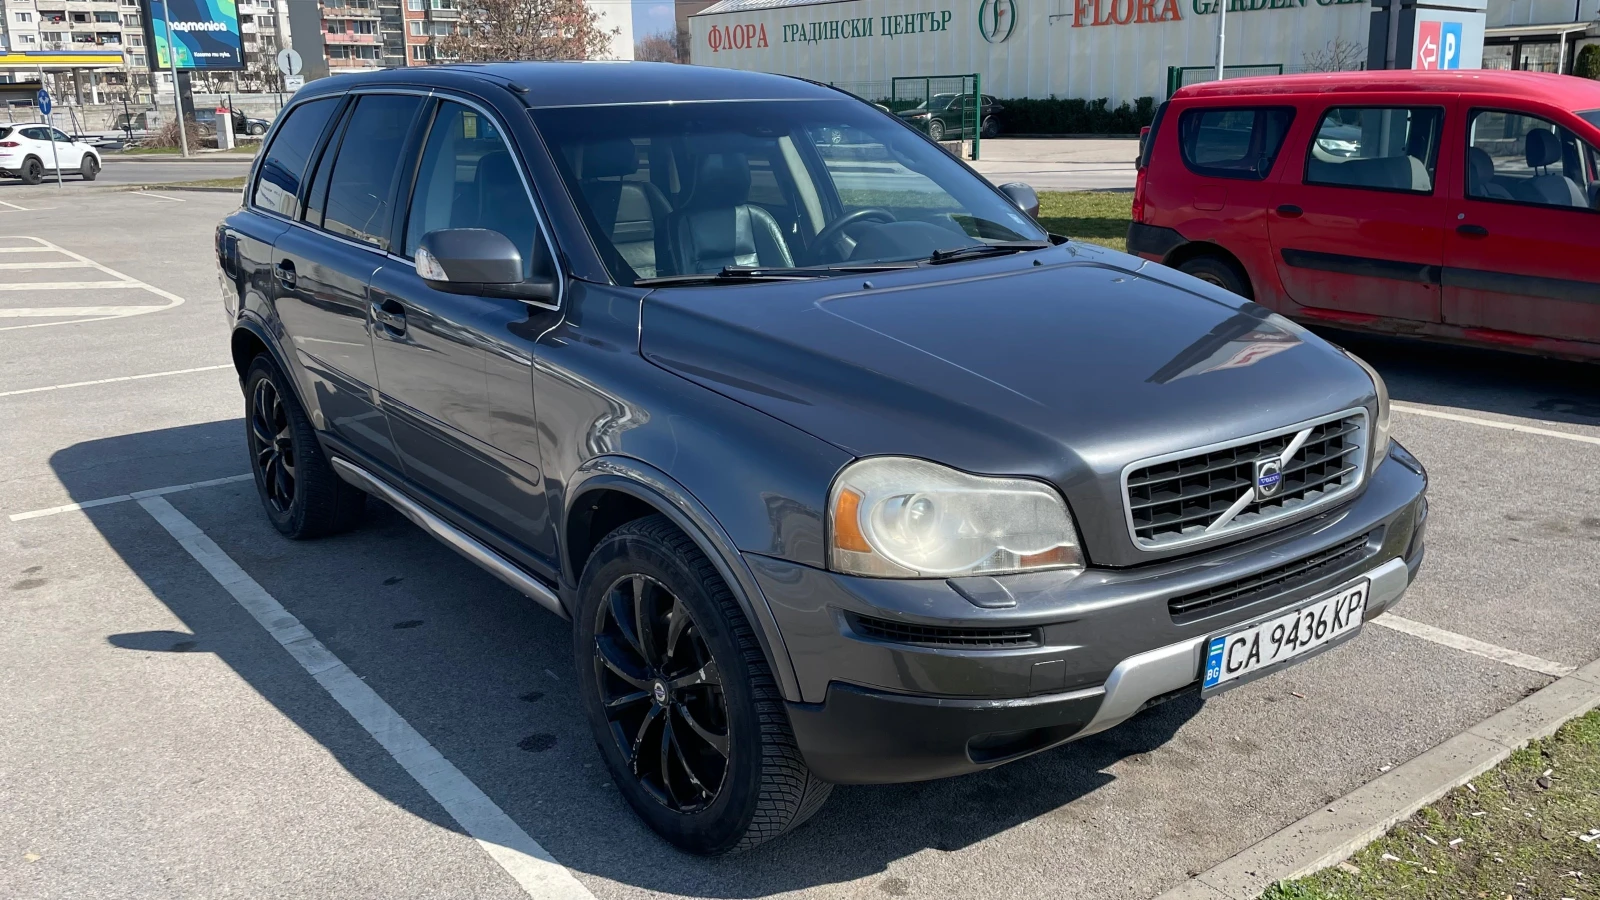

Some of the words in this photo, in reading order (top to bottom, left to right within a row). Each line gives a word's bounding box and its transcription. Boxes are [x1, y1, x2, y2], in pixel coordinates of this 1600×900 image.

[708, 23, 769, 53] ФЛОРА
[783, 17, 874, 46] ГРАДИНСКИ
[881, 10, 952, 40] ЦЕНТЪР
[1071, 0, 1182, 27] FLORA
[1443, 32, 1456, 70] P
[1226, 632, 1261, 674] CA
[1270, 605, 1328, 660] 9436
[1330, 590, 1362, 634] KP
[1206, 667, 1220, 681] BG
